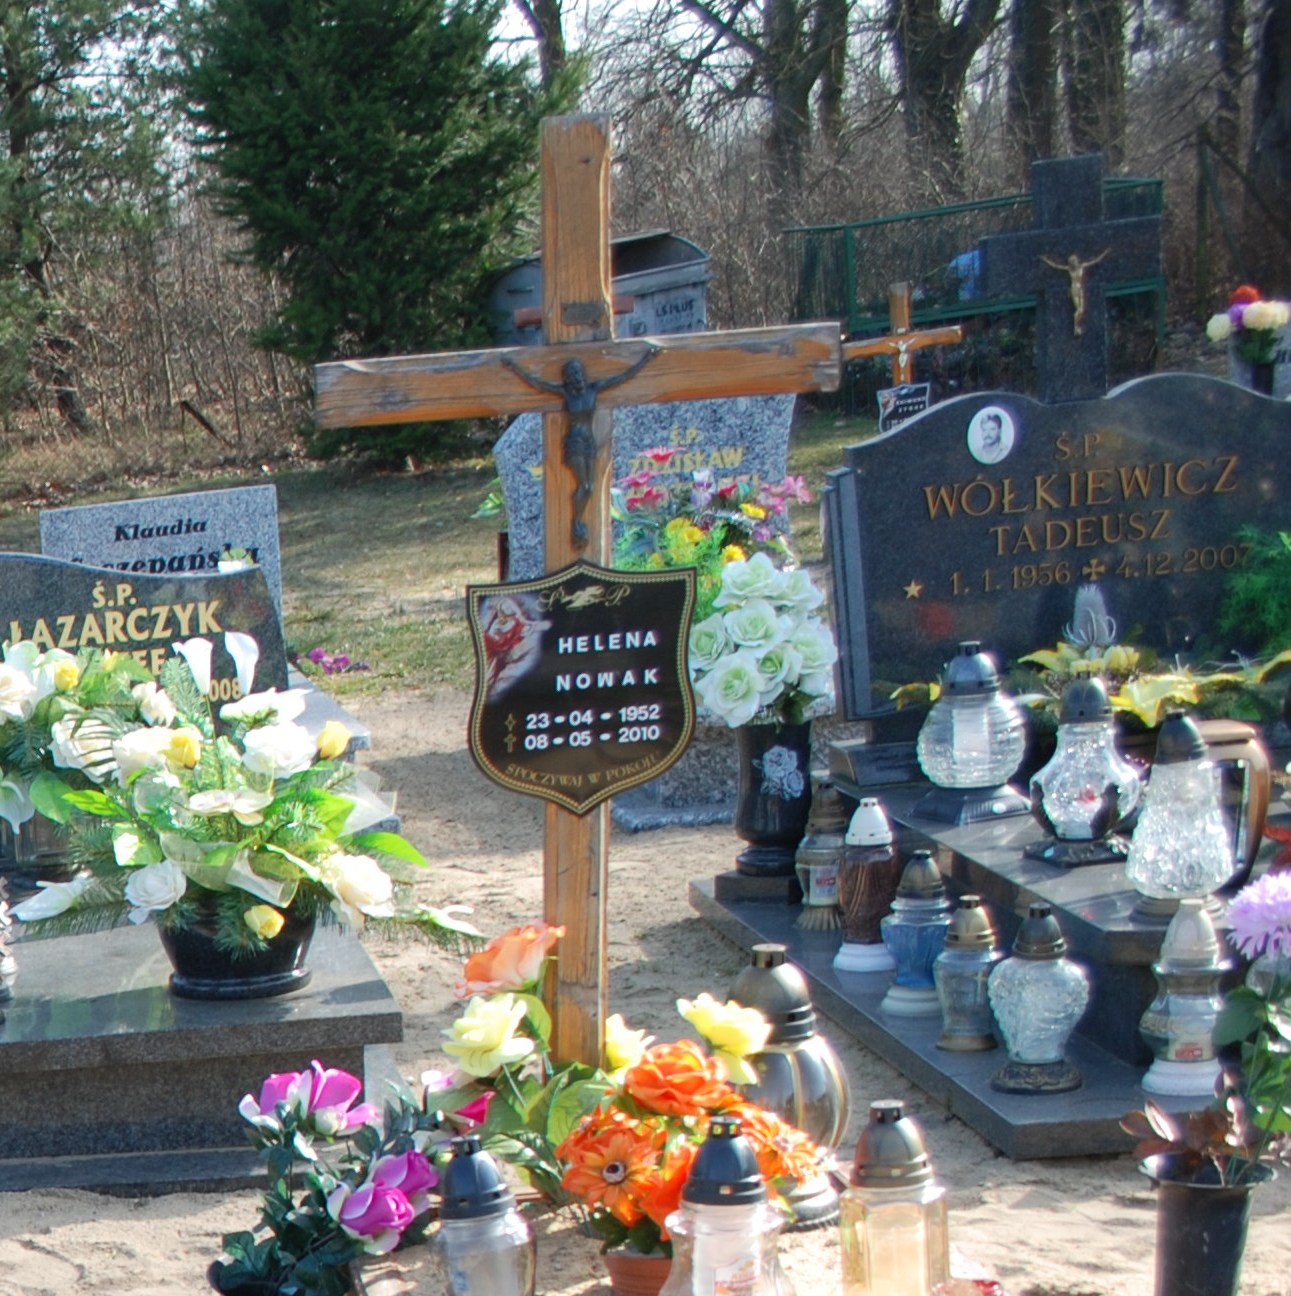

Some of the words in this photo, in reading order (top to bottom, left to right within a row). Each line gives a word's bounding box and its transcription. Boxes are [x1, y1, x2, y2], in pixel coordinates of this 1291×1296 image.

[922, 455, 1239, 520] WÓŁKIEWICZ
[114, 517, 208, 542] Klaudia
[989, 508, 1172, 556] TADEUSZ
[1010, 560, 1071, 588] 1956
[9, 599, 223, 653] ŁAZARCZYK
[558, 631, 657, 654] HELENA
[203, 678, 242, 703] 008
[555, 668, 659, 692] NOWAK
